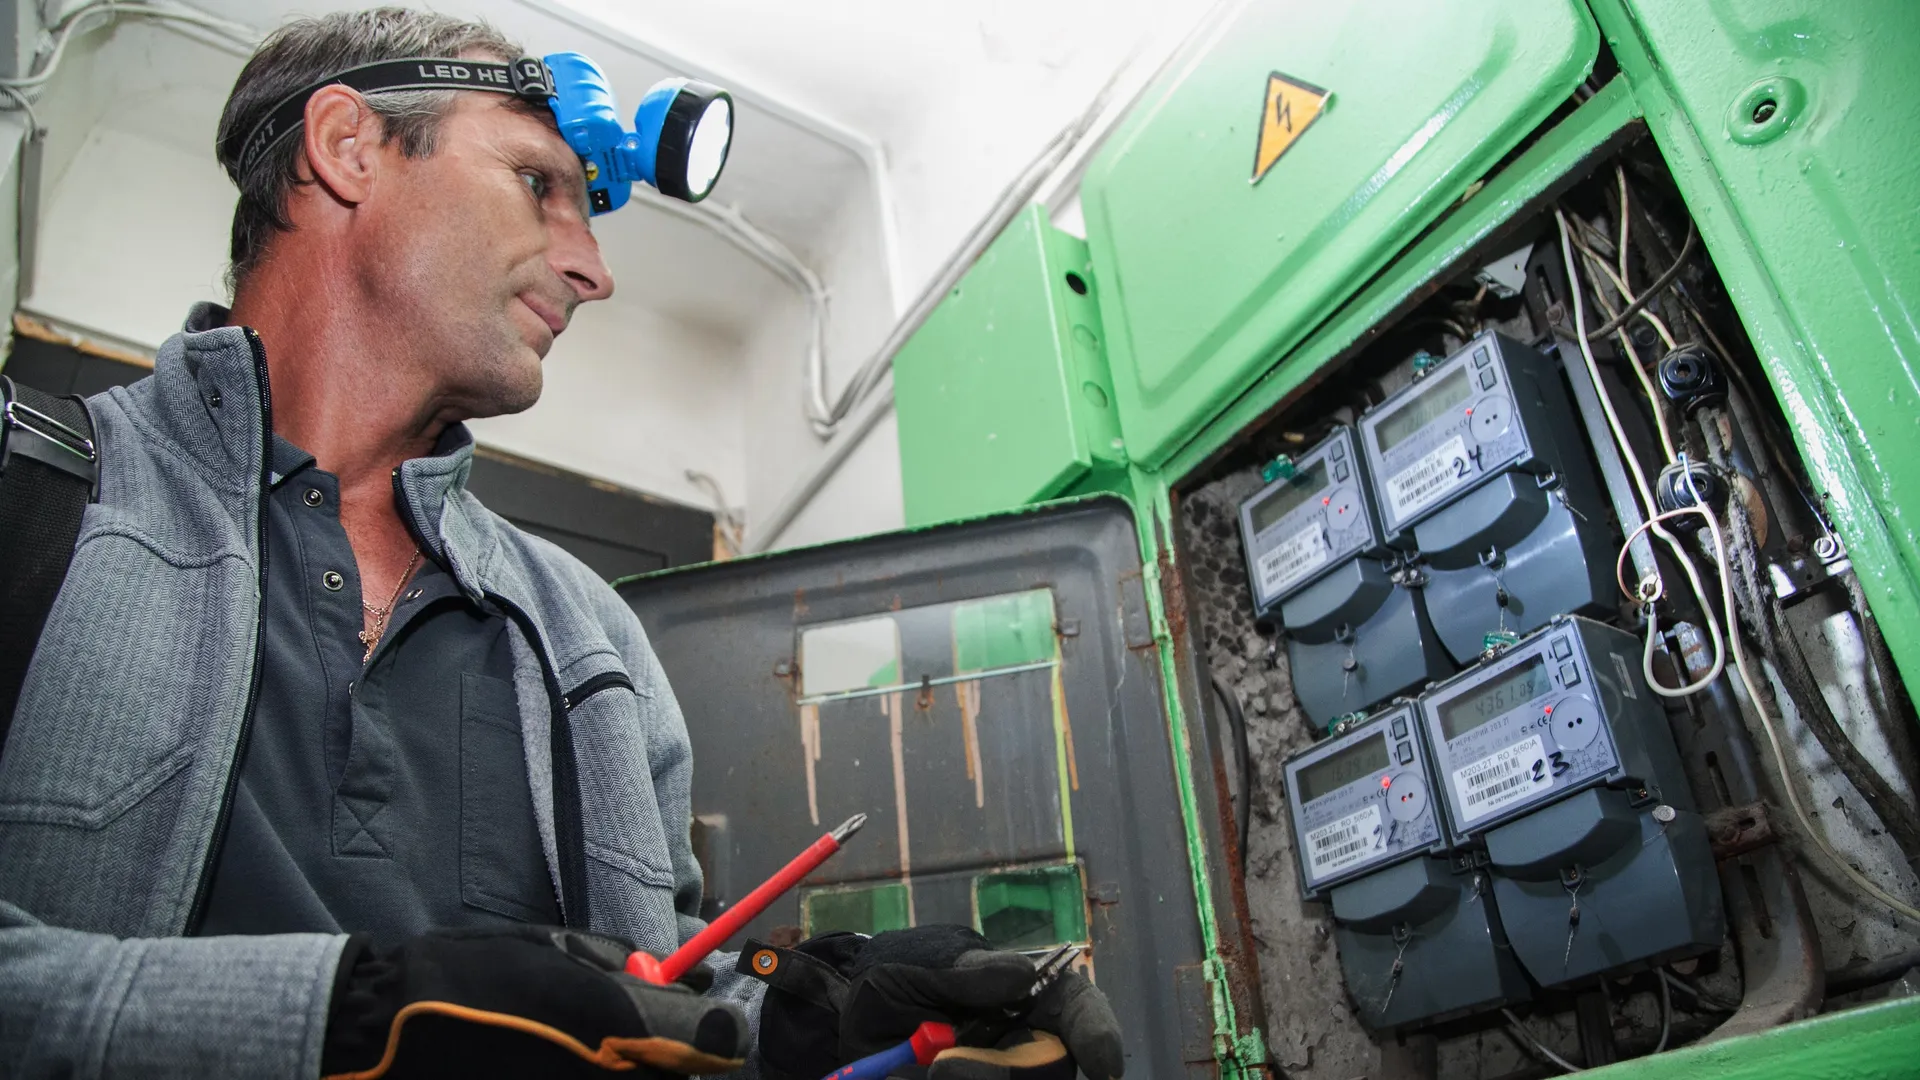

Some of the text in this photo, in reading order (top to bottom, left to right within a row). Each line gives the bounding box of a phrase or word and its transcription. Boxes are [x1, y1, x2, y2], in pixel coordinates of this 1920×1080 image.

[418, 65, 471, 80] LED
[1453, 444, 1484, 479] 24
[1460, 759, 1492, 779] M203.2T
[1497, 751, 1510, 762] RO
[1532, 751, 1570, 783] 23
